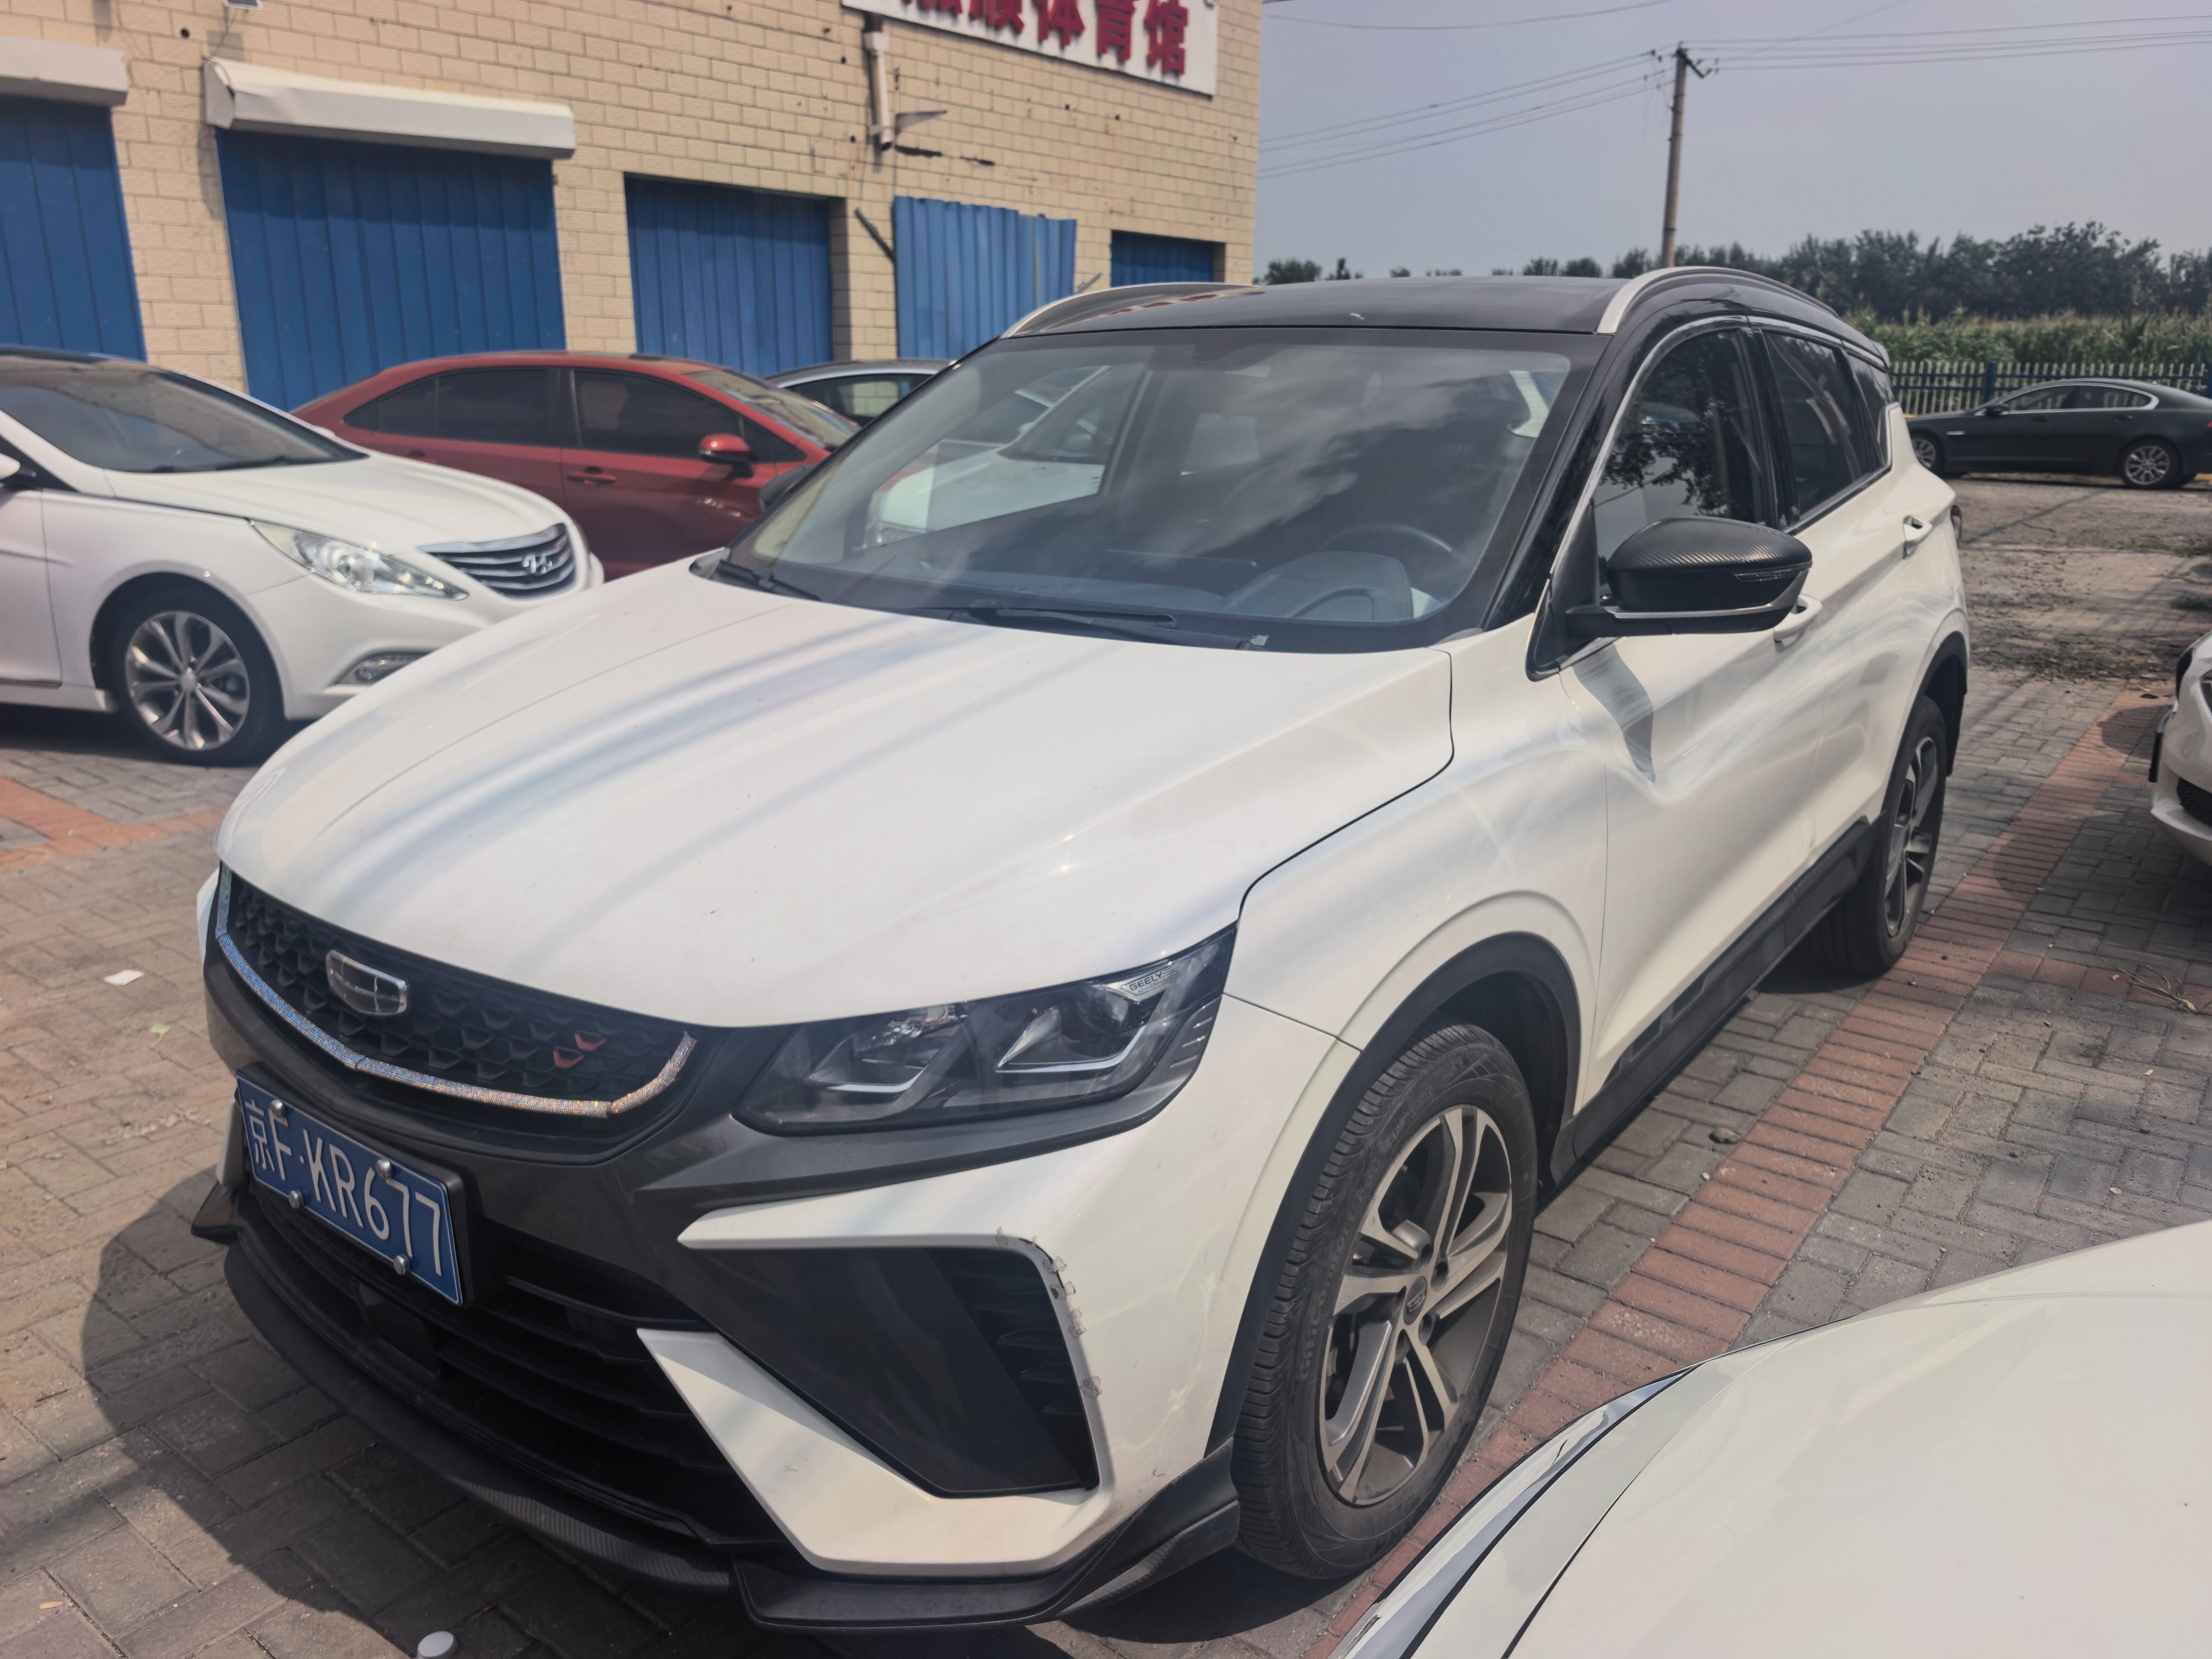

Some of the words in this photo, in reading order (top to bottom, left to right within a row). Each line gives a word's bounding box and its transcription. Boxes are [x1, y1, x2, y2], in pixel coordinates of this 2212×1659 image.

[900, 0, 1189, 76] 体育馆
[1129, 971, 1163, 991] GEELY
